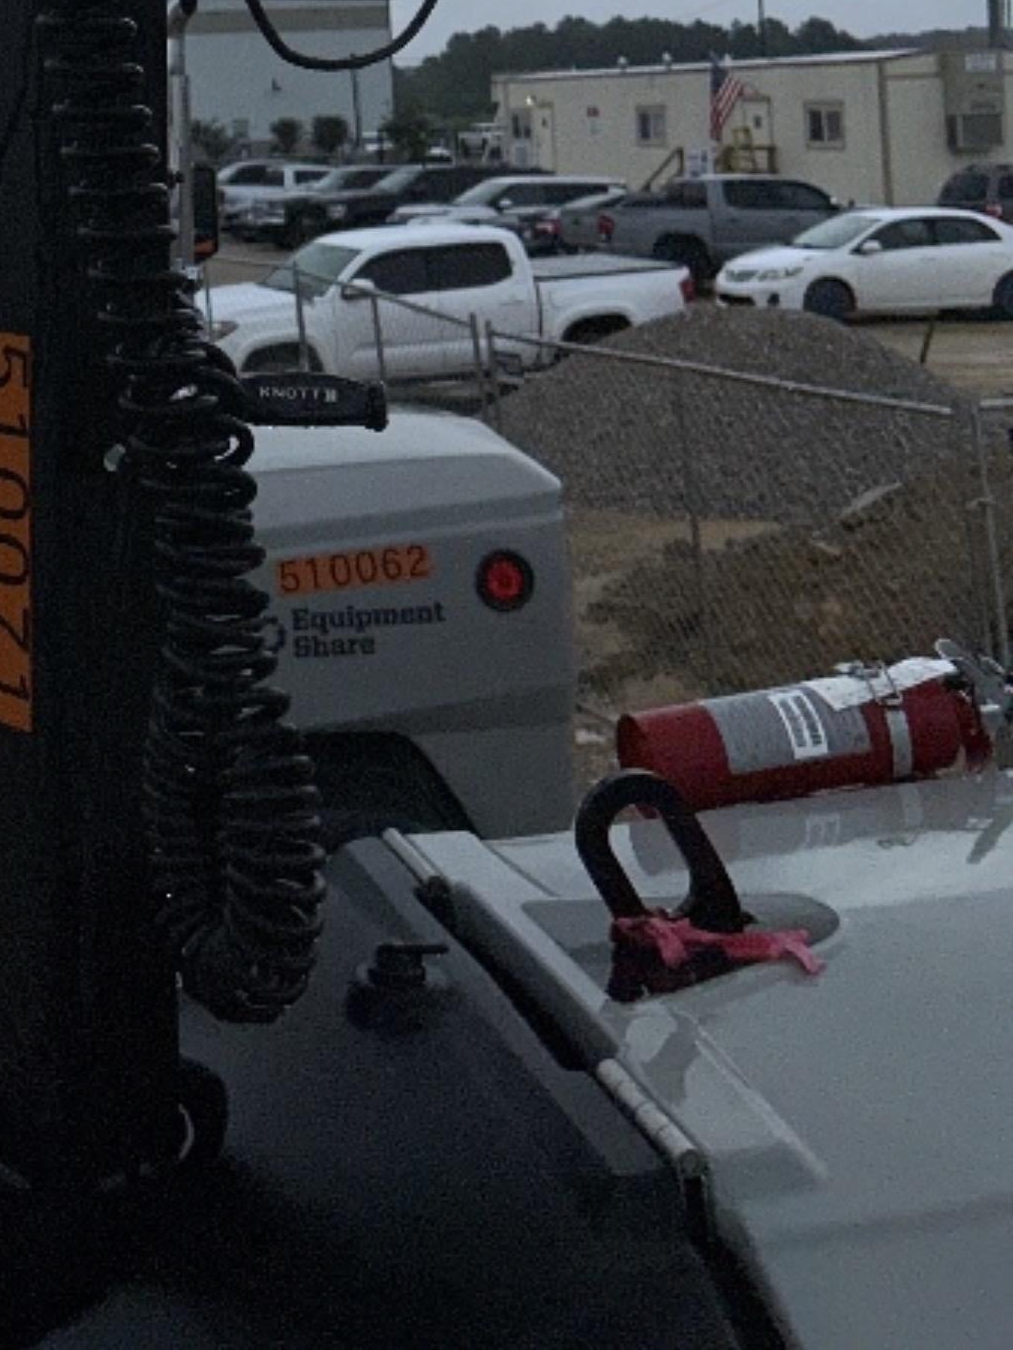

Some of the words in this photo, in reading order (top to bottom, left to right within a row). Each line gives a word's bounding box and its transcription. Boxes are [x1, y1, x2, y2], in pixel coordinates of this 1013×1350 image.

[280, 545, 426, 592] 510062
[291, 601, 447, 635] Equipment
[293, 635, 376, 659] Share
